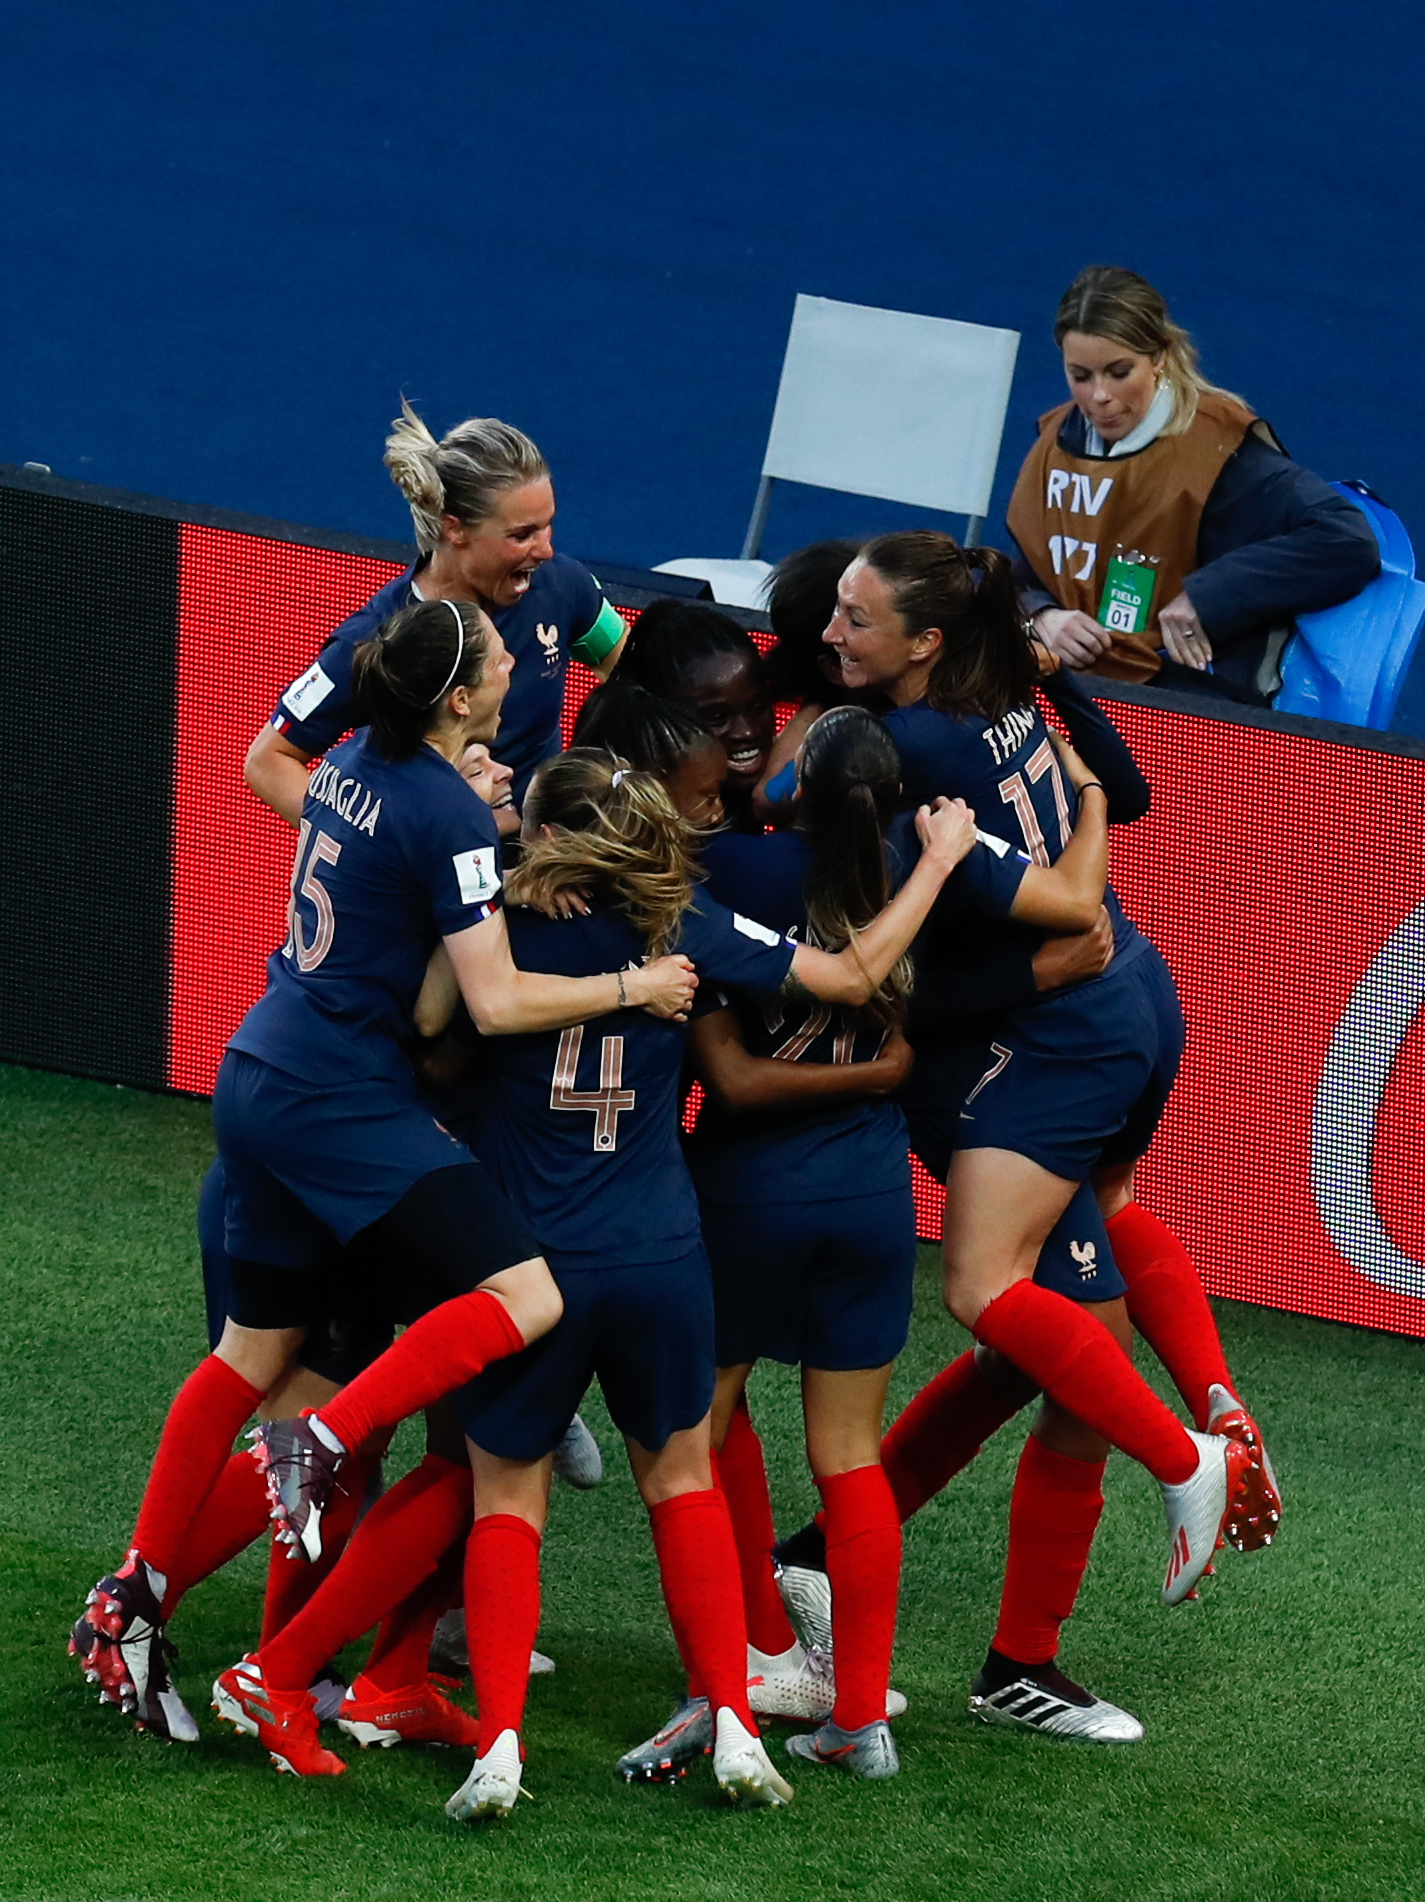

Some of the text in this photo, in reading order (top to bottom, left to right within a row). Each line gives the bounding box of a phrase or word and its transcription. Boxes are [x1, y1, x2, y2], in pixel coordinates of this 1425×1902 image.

[1047, 468, 1114, 517] RTV
[1110, 588, 1142, 606] FIELD
[1111, 609, 1130, 628] 01
[982, 704, 1036, 765] THIN
[998, 737, 1074, 868] 17
[549, 1024, 636, 1152] 4
